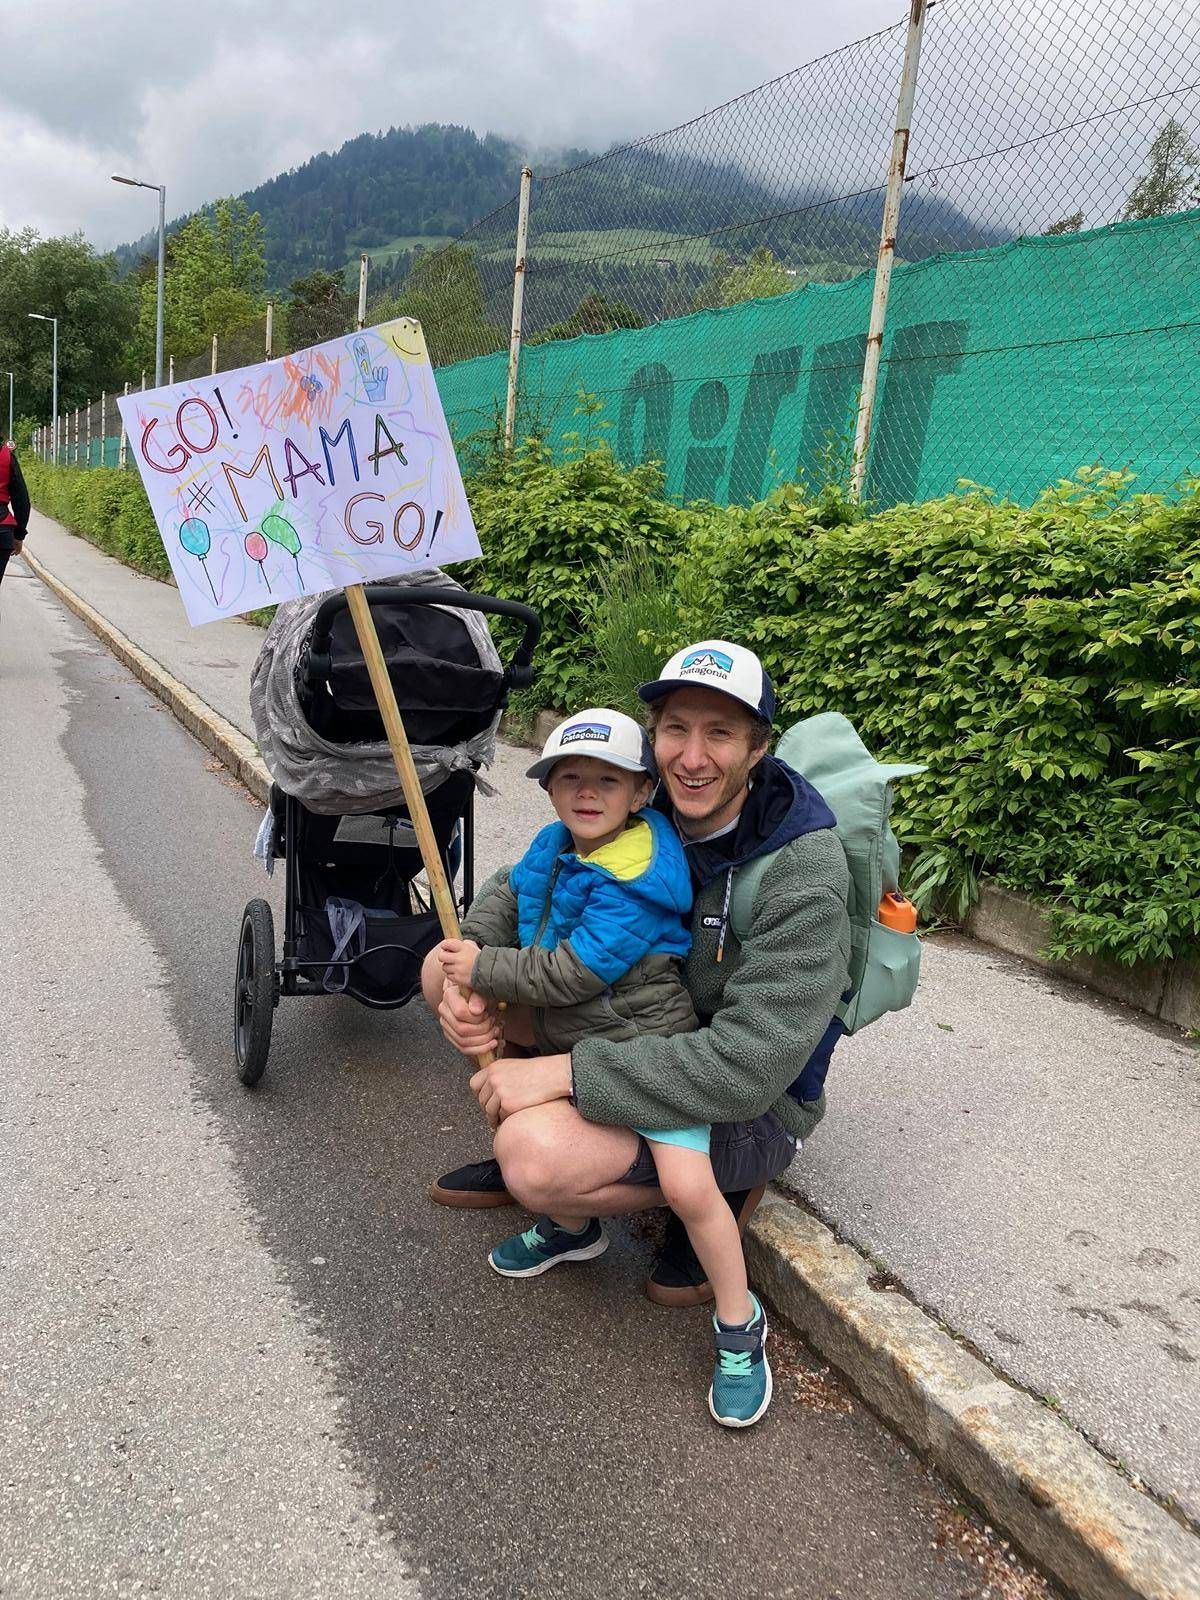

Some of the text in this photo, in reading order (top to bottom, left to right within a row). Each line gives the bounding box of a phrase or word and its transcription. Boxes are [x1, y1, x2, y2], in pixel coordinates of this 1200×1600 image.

[141, 387, 239, 474] GO!
[344, 492, 444, 558] GO!
[679, 666, 728, 680] patagonia
[562, 732, 606, 744] patagonia
